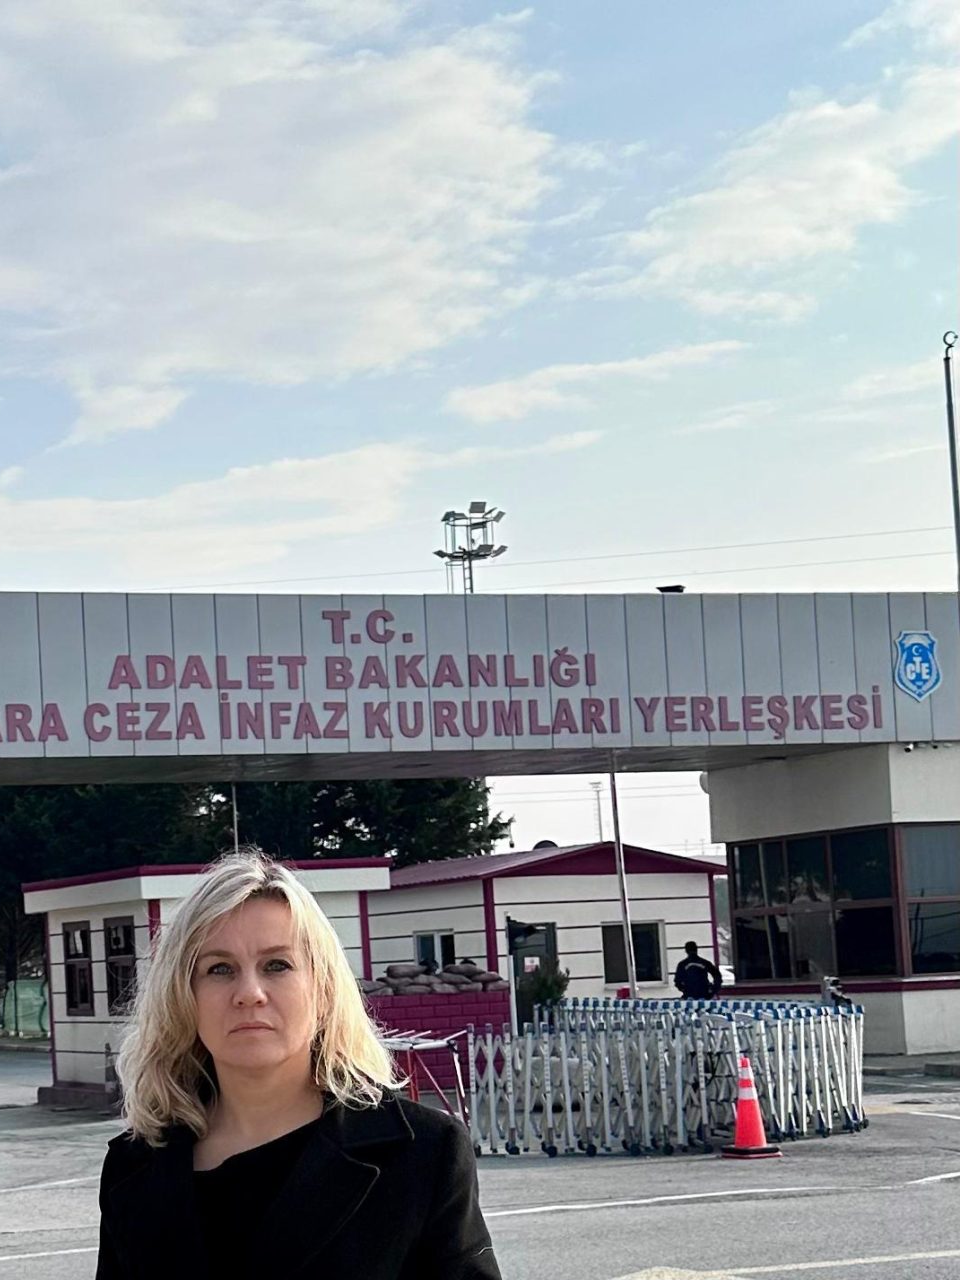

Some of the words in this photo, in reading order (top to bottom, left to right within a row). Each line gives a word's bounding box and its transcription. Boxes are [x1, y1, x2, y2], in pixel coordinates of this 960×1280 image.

[322, 610, 413, 643] T.C.
[108, 655, 307, 690] ADALET
[325, 647, 596, 690] BAKANLIĞI
[83, 702, 205, 742] CEZA
[219, 692, 349, 740] İNFAZ
[364, 697, 621, 738] KURUMLARI
[633, 685, 883, 740] YERLEŞKESİ
